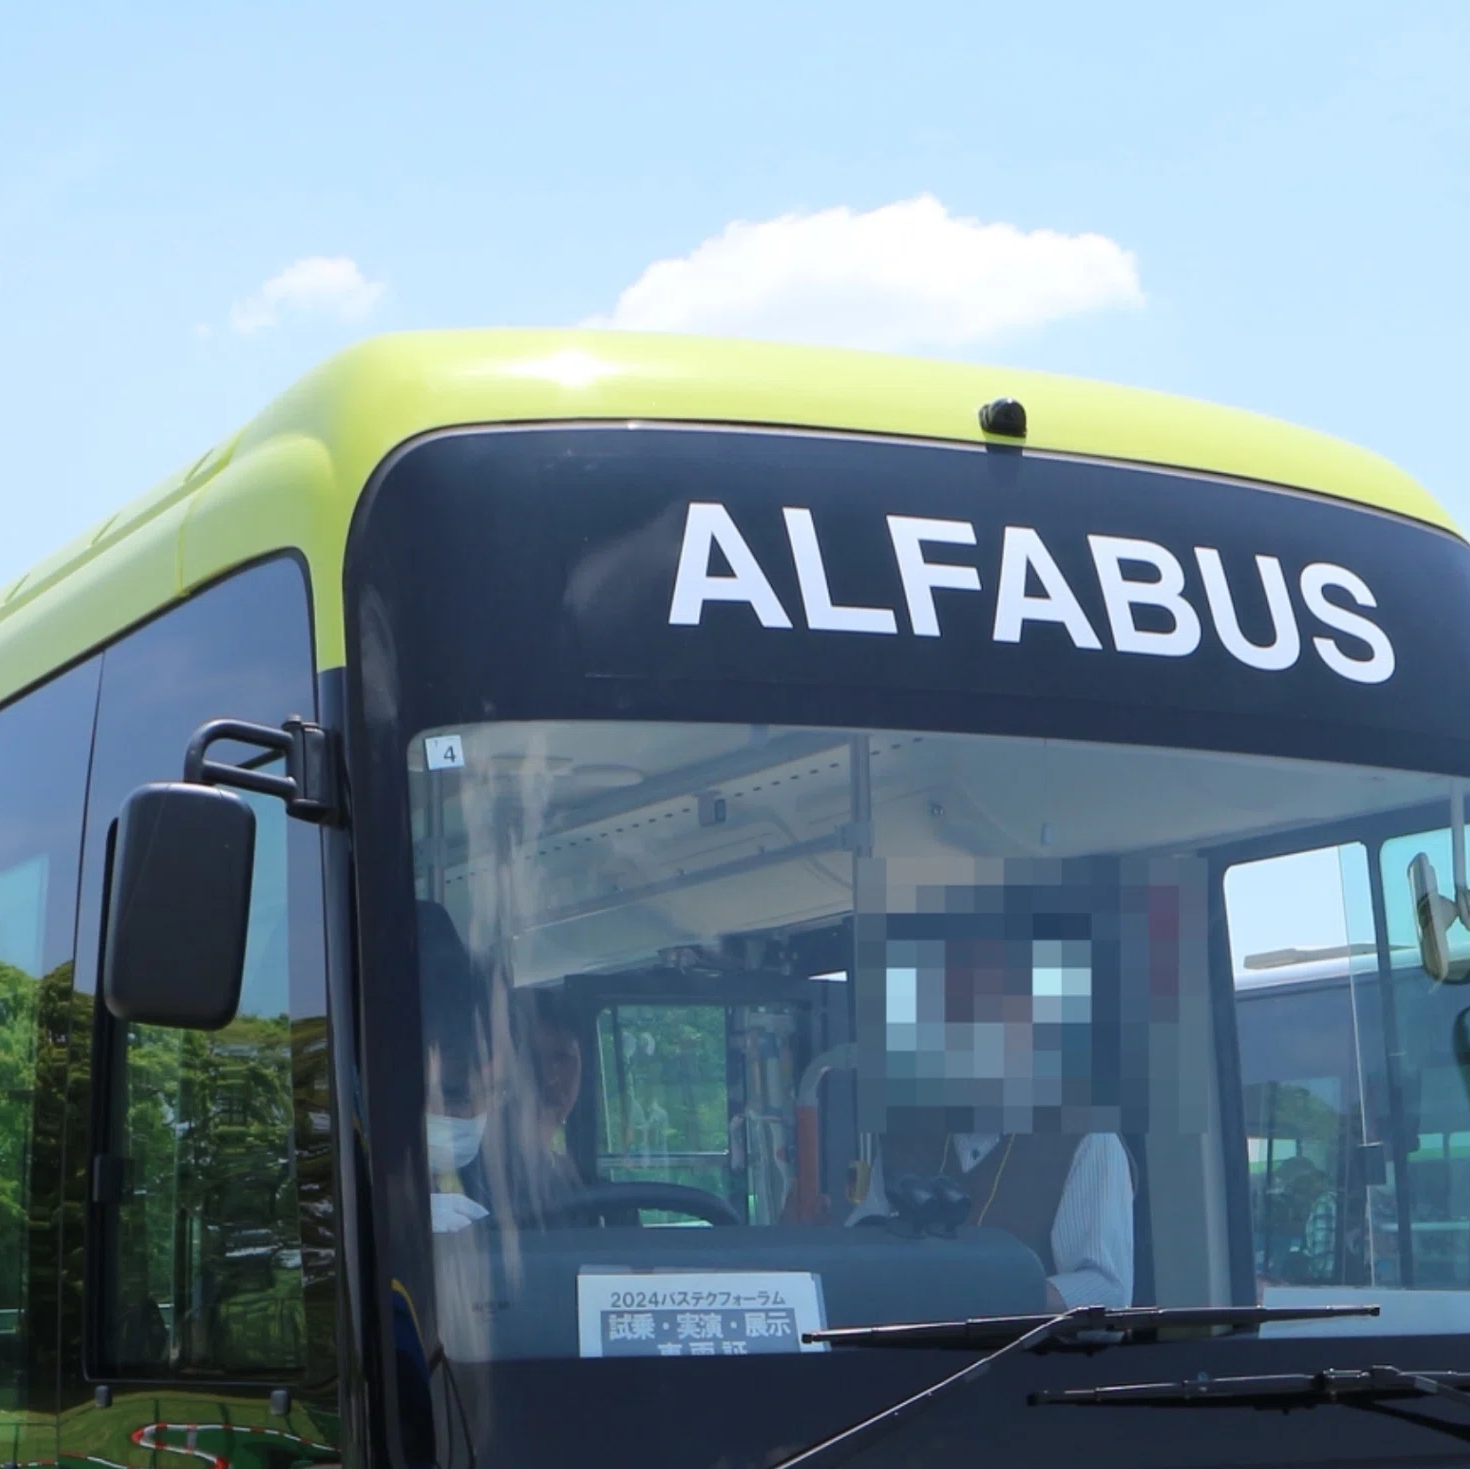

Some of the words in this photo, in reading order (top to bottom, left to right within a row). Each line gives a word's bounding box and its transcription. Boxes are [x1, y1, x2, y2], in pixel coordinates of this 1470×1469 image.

[668, 501, 1396, 684] ALFABUS
[443, 745, 457, 763] 4
[610, 1290, 787, 1309] 2024バステクフォーラム
[608, 1311, 792, 1341] 試乗・実演・展示
